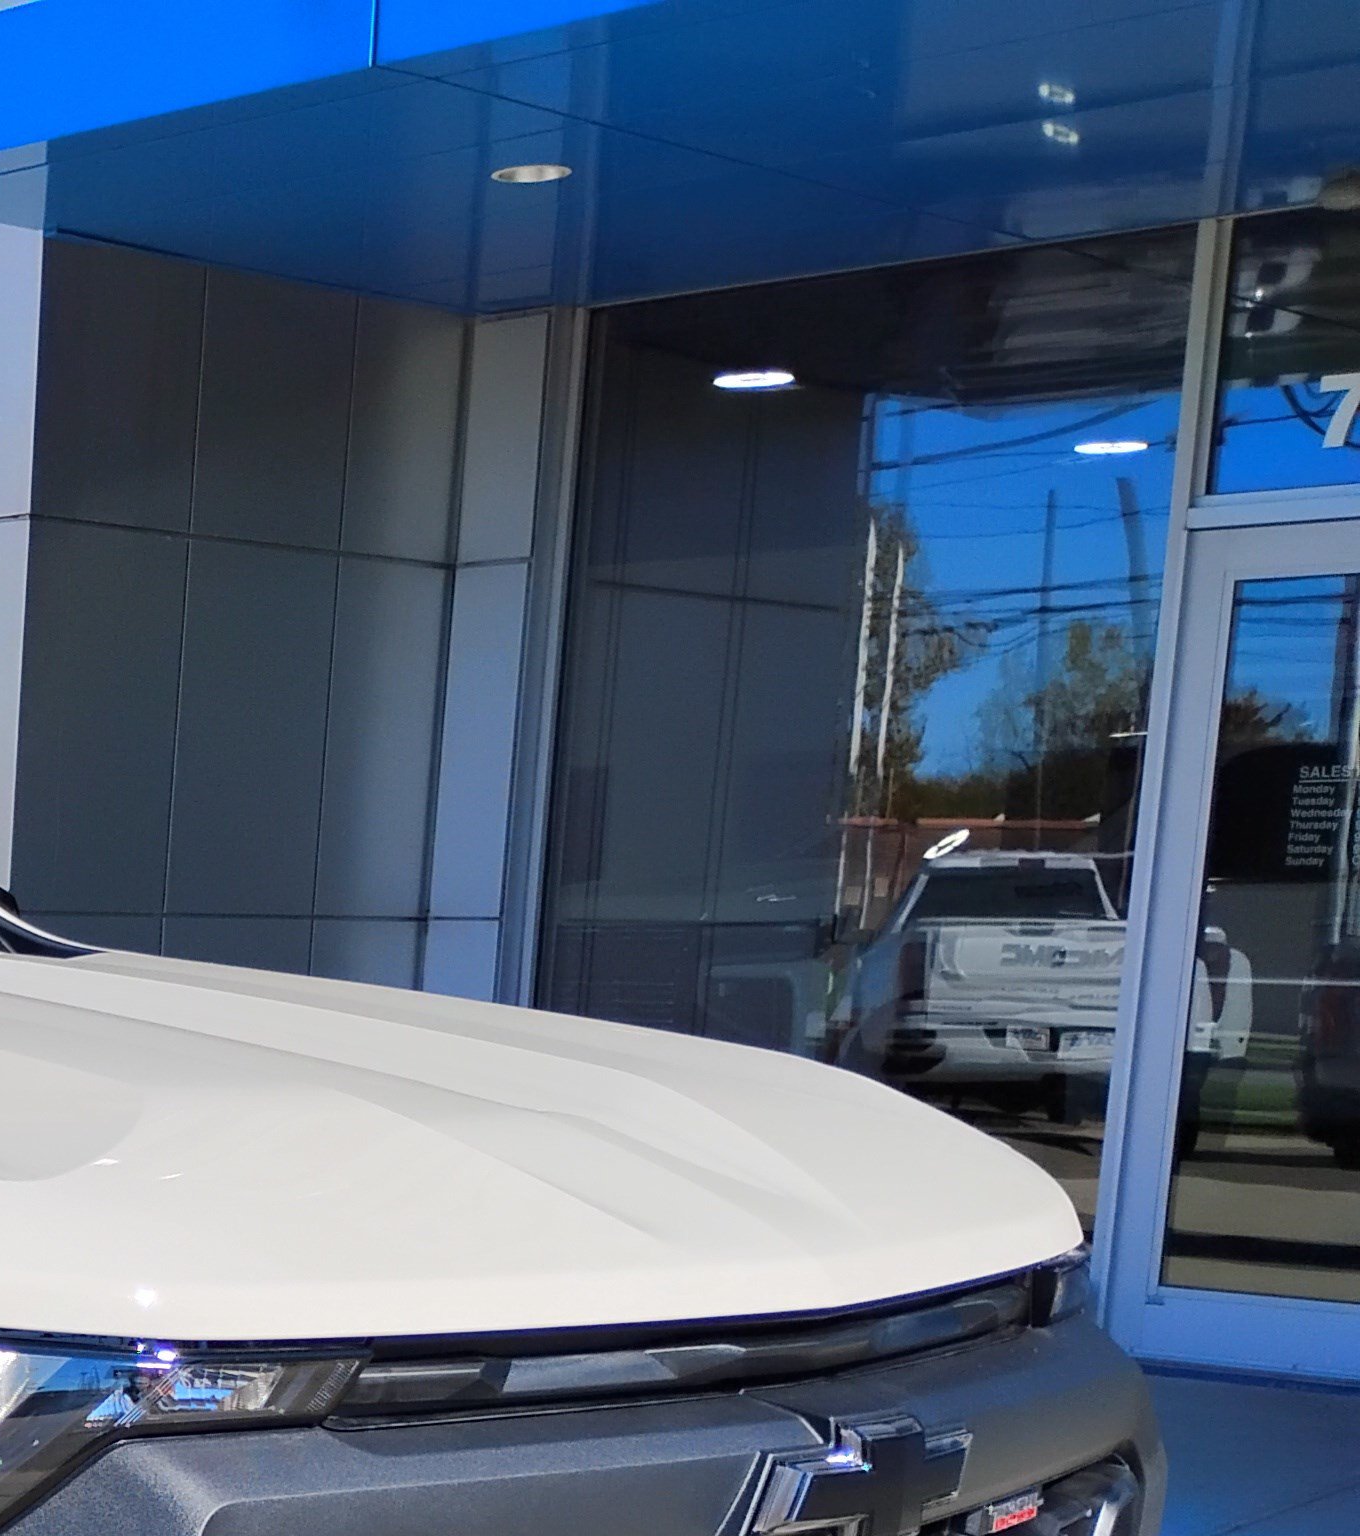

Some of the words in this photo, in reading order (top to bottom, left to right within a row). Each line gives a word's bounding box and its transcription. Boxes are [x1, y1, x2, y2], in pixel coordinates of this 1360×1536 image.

[1300, 765, 1352, 779] SALES
[1292, 784, 1336, 795] Monday
[1292, 797, 1335, 807] Tuesday
[1290, 821, 1340, 831] Thursday
[1288, 832, 1321, 843] Friday
[1287, 844, 1334, 855] Saturday
[1285, 856, 1326, 867] Sunday
